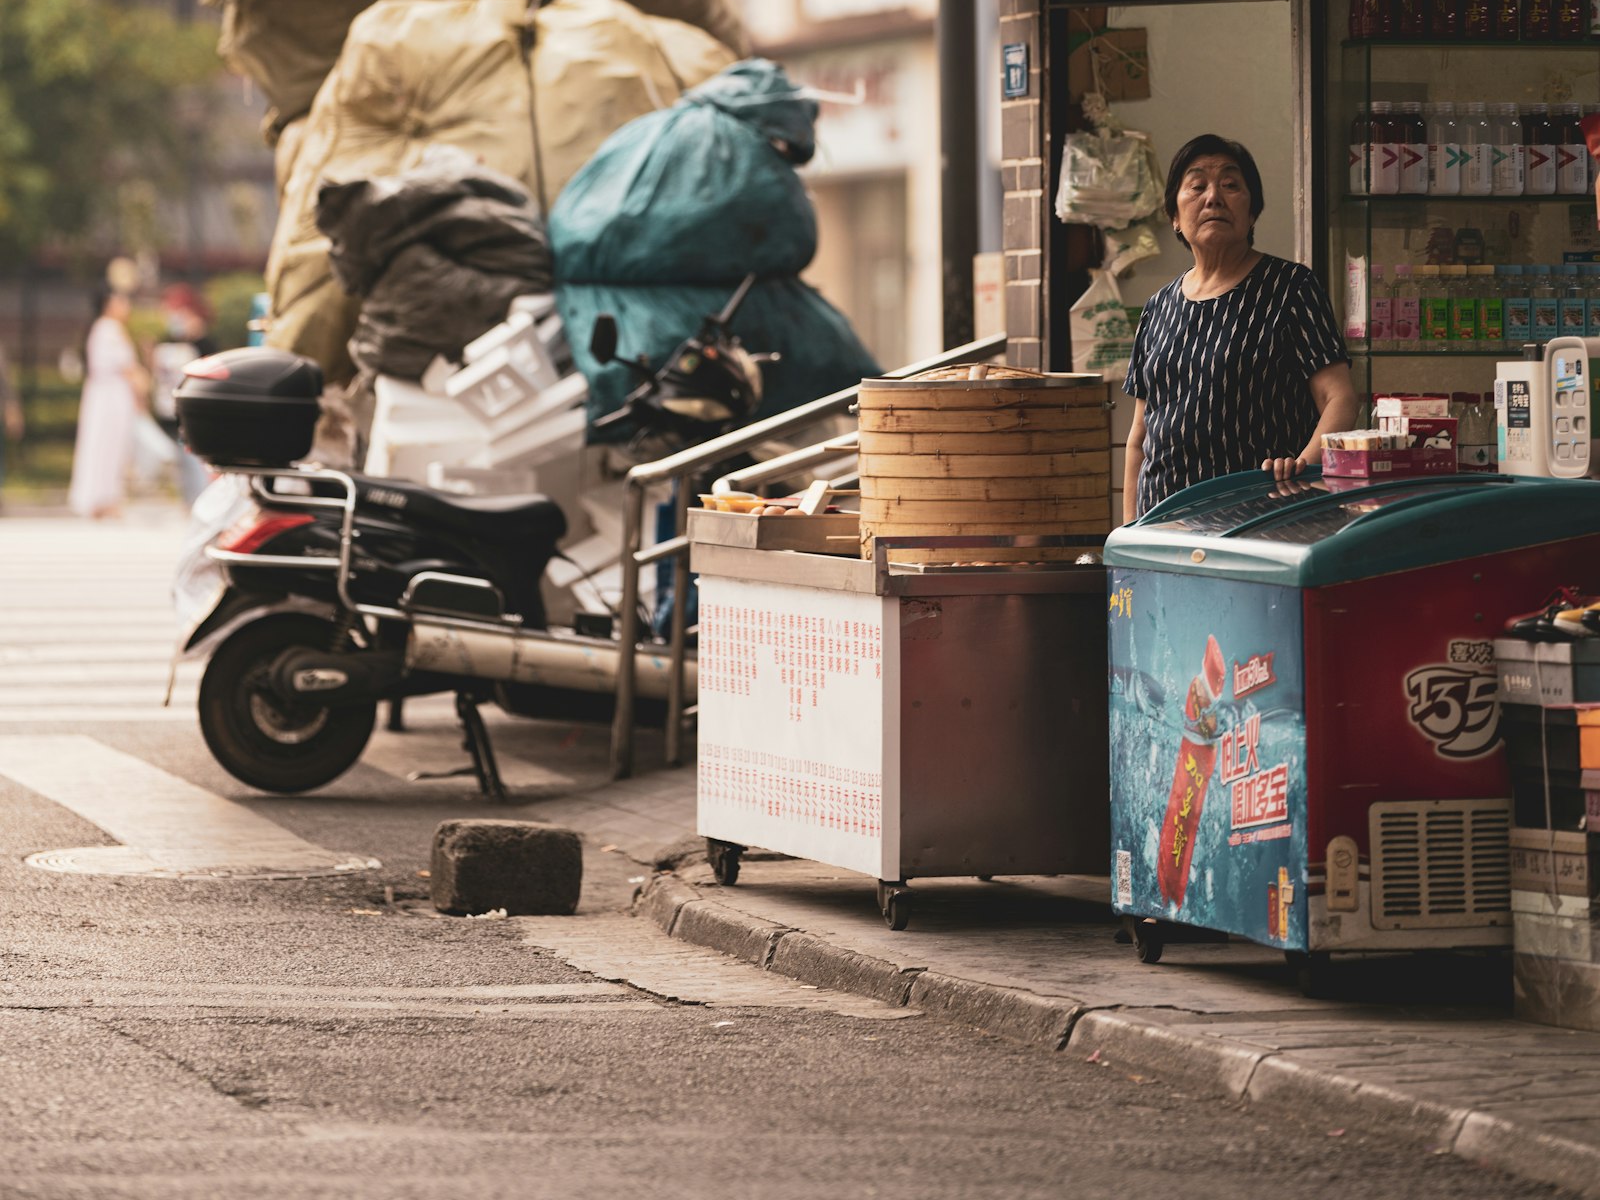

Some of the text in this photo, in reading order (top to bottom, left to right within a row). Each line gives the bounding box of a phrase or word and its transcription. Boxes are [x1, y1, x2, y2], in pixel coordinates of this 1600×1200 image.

[1220, 711, 1262, 787] 怕上火
[1230, 762, 1289, 831] 喝加多宝
